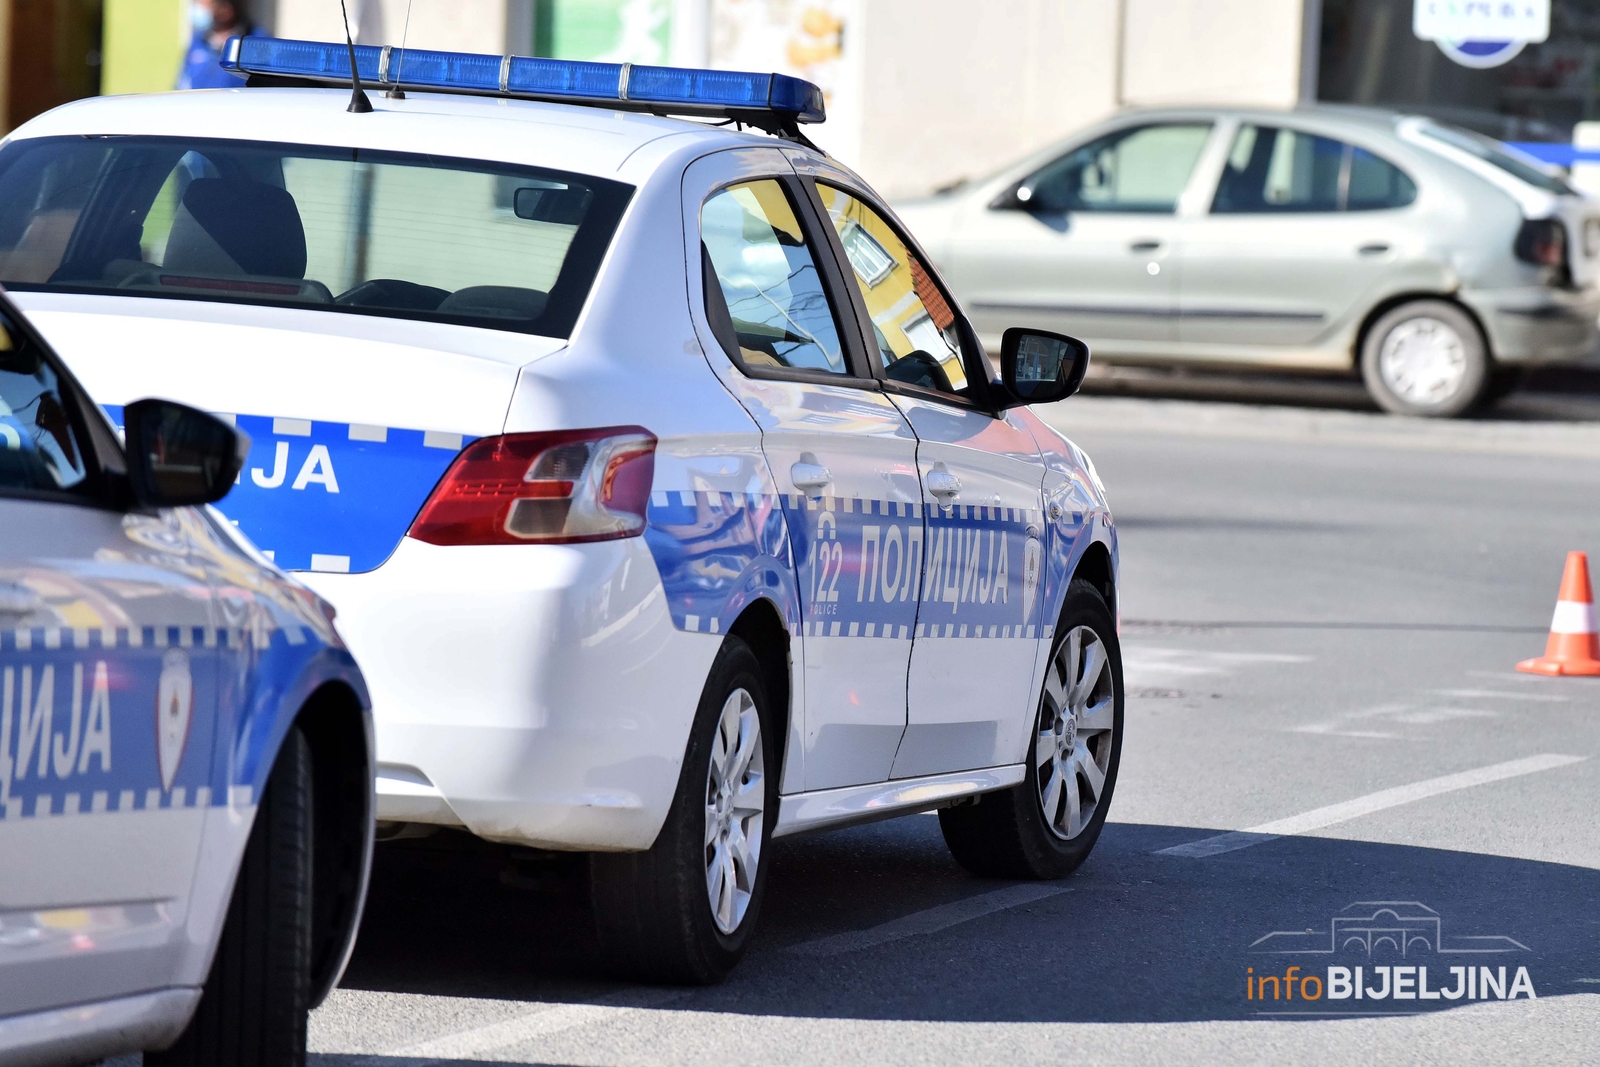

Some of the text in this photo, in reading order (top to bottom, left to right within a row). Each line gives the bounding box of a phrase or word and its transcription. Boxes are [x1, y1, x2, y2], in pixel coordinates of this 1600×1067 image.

[809, 541, 843, 602] 122
[857, 524, 1008, 614] ПОЛИЦИЈА
[809, 604, 838, 615] POLICE
